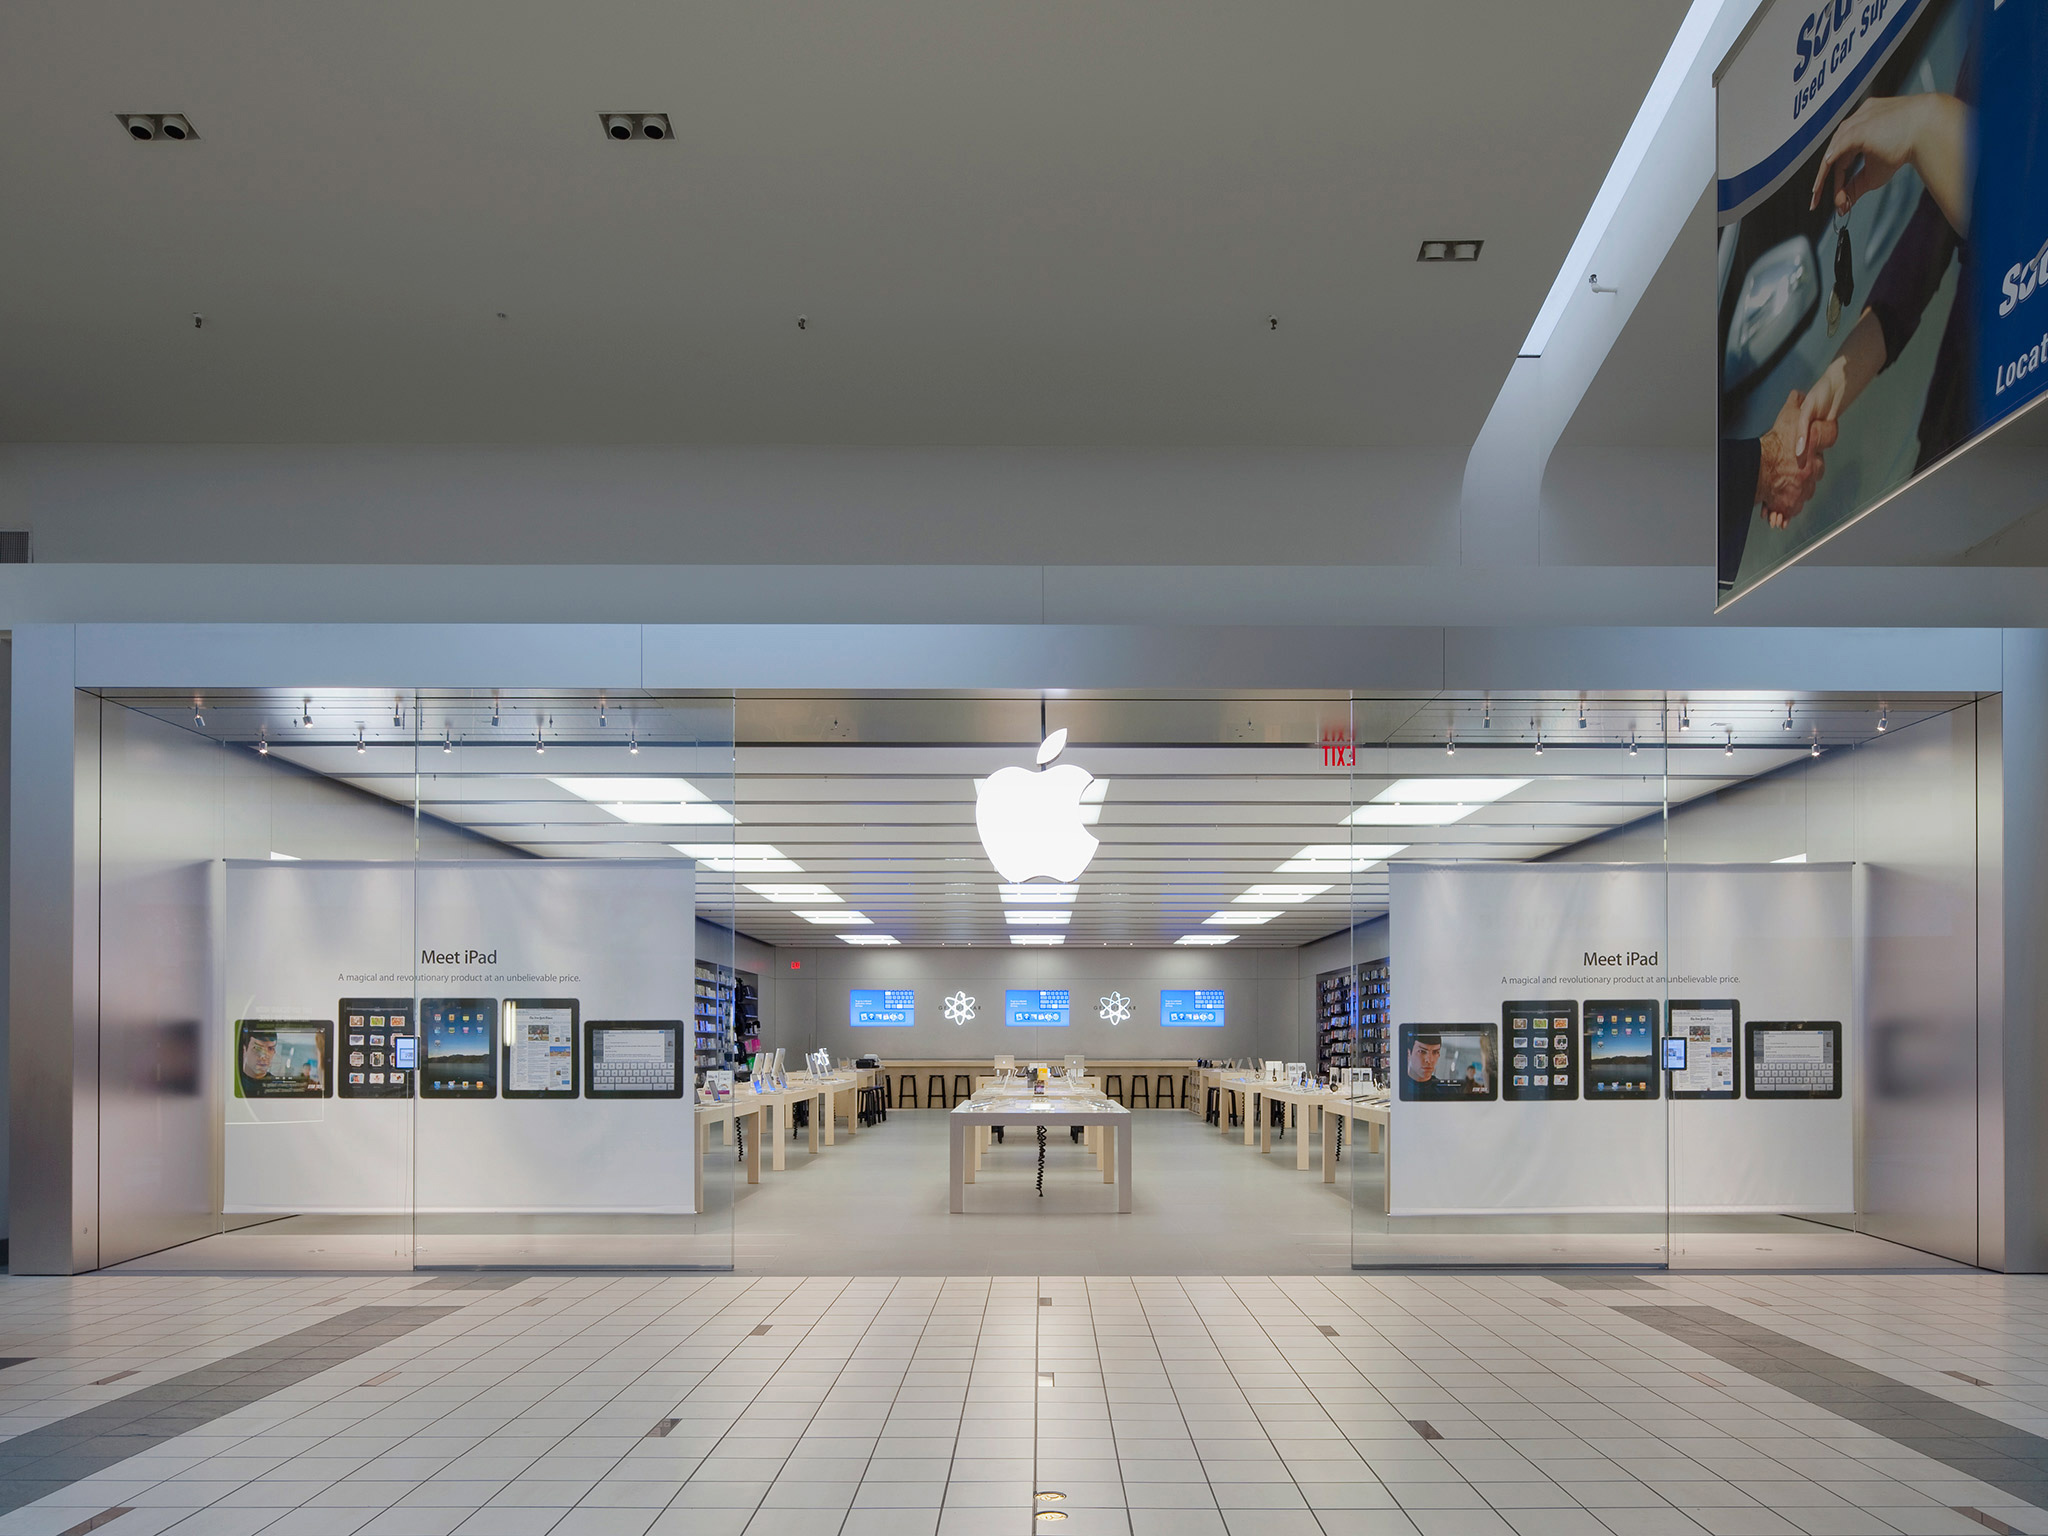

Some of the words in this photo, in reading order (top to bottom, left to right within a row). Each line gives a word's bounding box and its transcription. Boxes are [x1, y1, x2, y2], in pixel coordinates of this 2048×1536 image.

[1794, 59, 1826, 120] Used
[1830, 27, 1856, 73] Car
[421, 950, 460, 965] Meet
[464, 950, 498, 965] iPad
[1583, 952, 1622, 966] Meet
[1626, 951, 1658, 966] iPad
[338, 973, 345, 982] A
[346, 973, 378, 984] magical
[379, 973, 395, 982] and
[450, 973, 483, 984] product
[484, 974, 493, 982] at
[506, 973, 558, 982] unbelievable
[559, 973, 582, 984] price.
[1501, 976, 1508, 985] A
[1509, 975, 1541, 986] magical
[1542, 975, 1557, 985] and
[1559, 975, 1611, 986] revolutionary
[1613, 974, 1645, 986] product
[1646, 975, 1654, 984] at
[1655, 976, 1666, 984] an
[1667, 974, 1718, 984] unbelievable
[1719, 974, 1741, 985] price.
